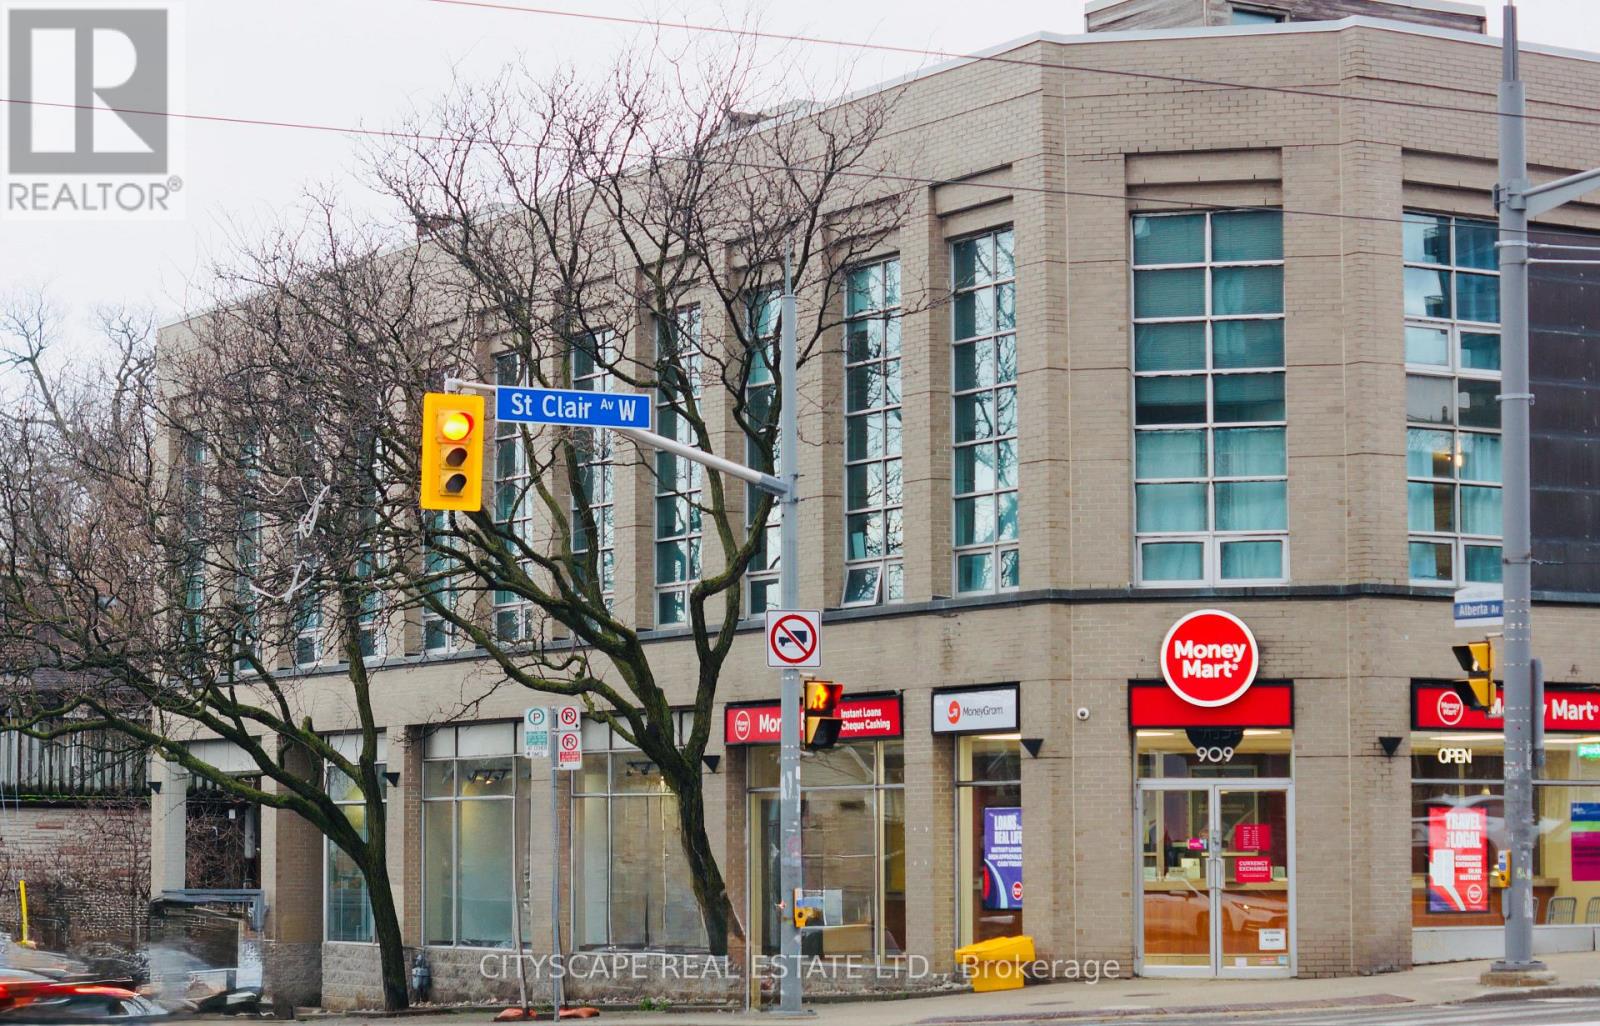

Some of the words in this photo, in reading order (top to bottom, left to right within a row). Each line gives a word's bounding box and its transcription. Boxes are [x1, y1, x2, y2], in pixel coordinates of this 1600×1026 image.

[511, 392, 533, 416] St
[542, 394, 592, 420] Clair
[600, 398, 614, 410] Av
[618, 399, 636, 422] W
[1458, 604, 1488, 616] Alberta
[1491, 605, 1500, 614] Av
[1174, 640, 1246, 663] Money
[840, 708, 862, 719] Instant
[863, 707, 881, 718] Loans
[962, 705, 1004, 718] MoneyGram
[841, 720, 864, 732] Cheque
[865, 719, 890, 731] Cashing
[1196, 746, 1234, 763] 909
[1437, 748, 1472, 764] OPEN
[1445, 812, 1482, 830] TRAVEL
